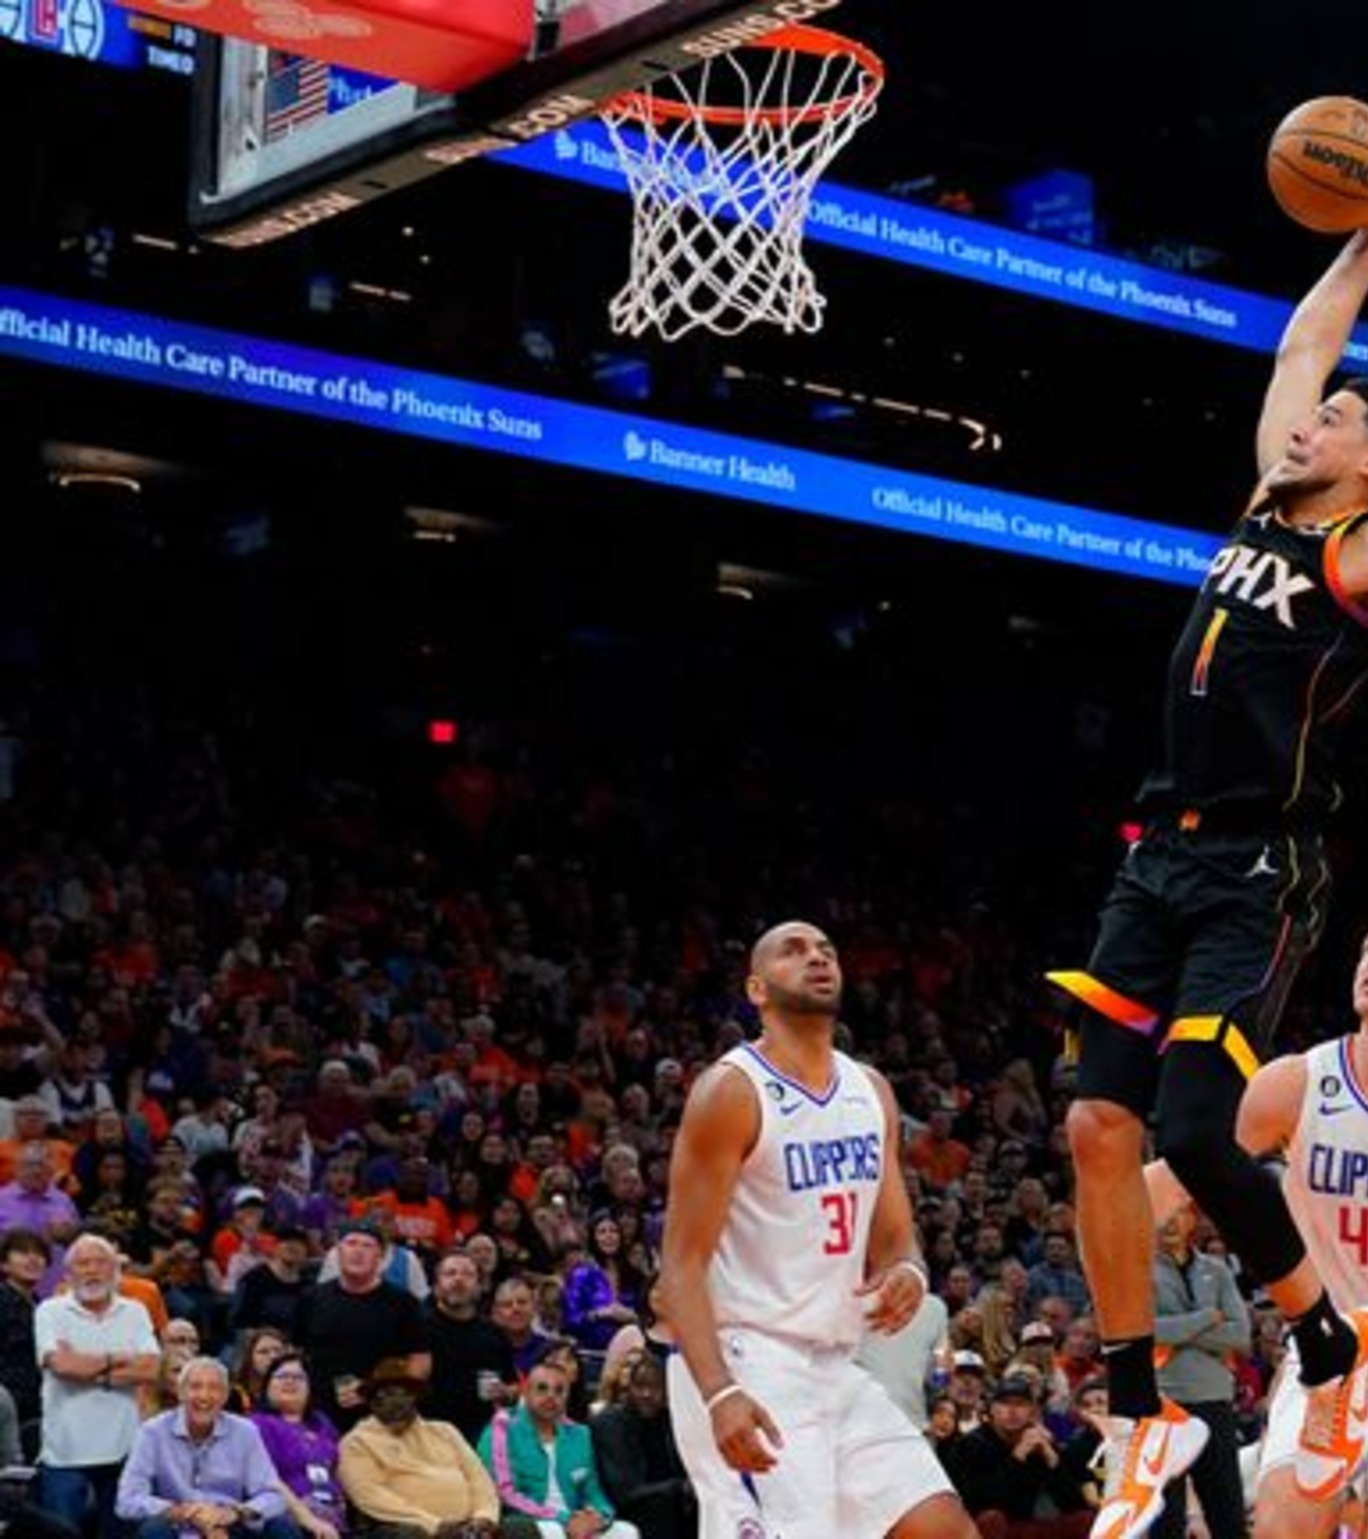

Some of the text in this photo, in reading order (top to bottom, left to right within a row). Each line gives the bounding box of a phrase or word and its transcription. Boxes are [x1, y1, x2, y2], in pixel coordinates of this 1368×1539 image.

[805, 200, 1236, 327] Official Health Care Partner of the Phoenix Suns
[76, 324, 161, 365] Health
[166, 345, 224, 376] Care
[228, 356, 317, 395] Partner
[322, 377, 347, 401] of
[349, 380, 388, 409] the
[392, 389, 484, 428] Phoenix
[488, 409, 542, 439] Suns
[650, 440, 795, 490] Banner Health
[872, 488, 942, 520] Official
[946, 501, 1007, 532] Health
[1011, 516, 1054, 541] Care
[1057, 524, 1121, 554] Partner
[1125, 539, 1143, 558] of
[1145, 542, 1175, 565] the
[1209, 545, 1316, 630] PHX
[1190, 606, 1228, 697] 1
[783, 1132, 880, 1193] CLIPPERS
[821, 1192, 858, 1255] 31
